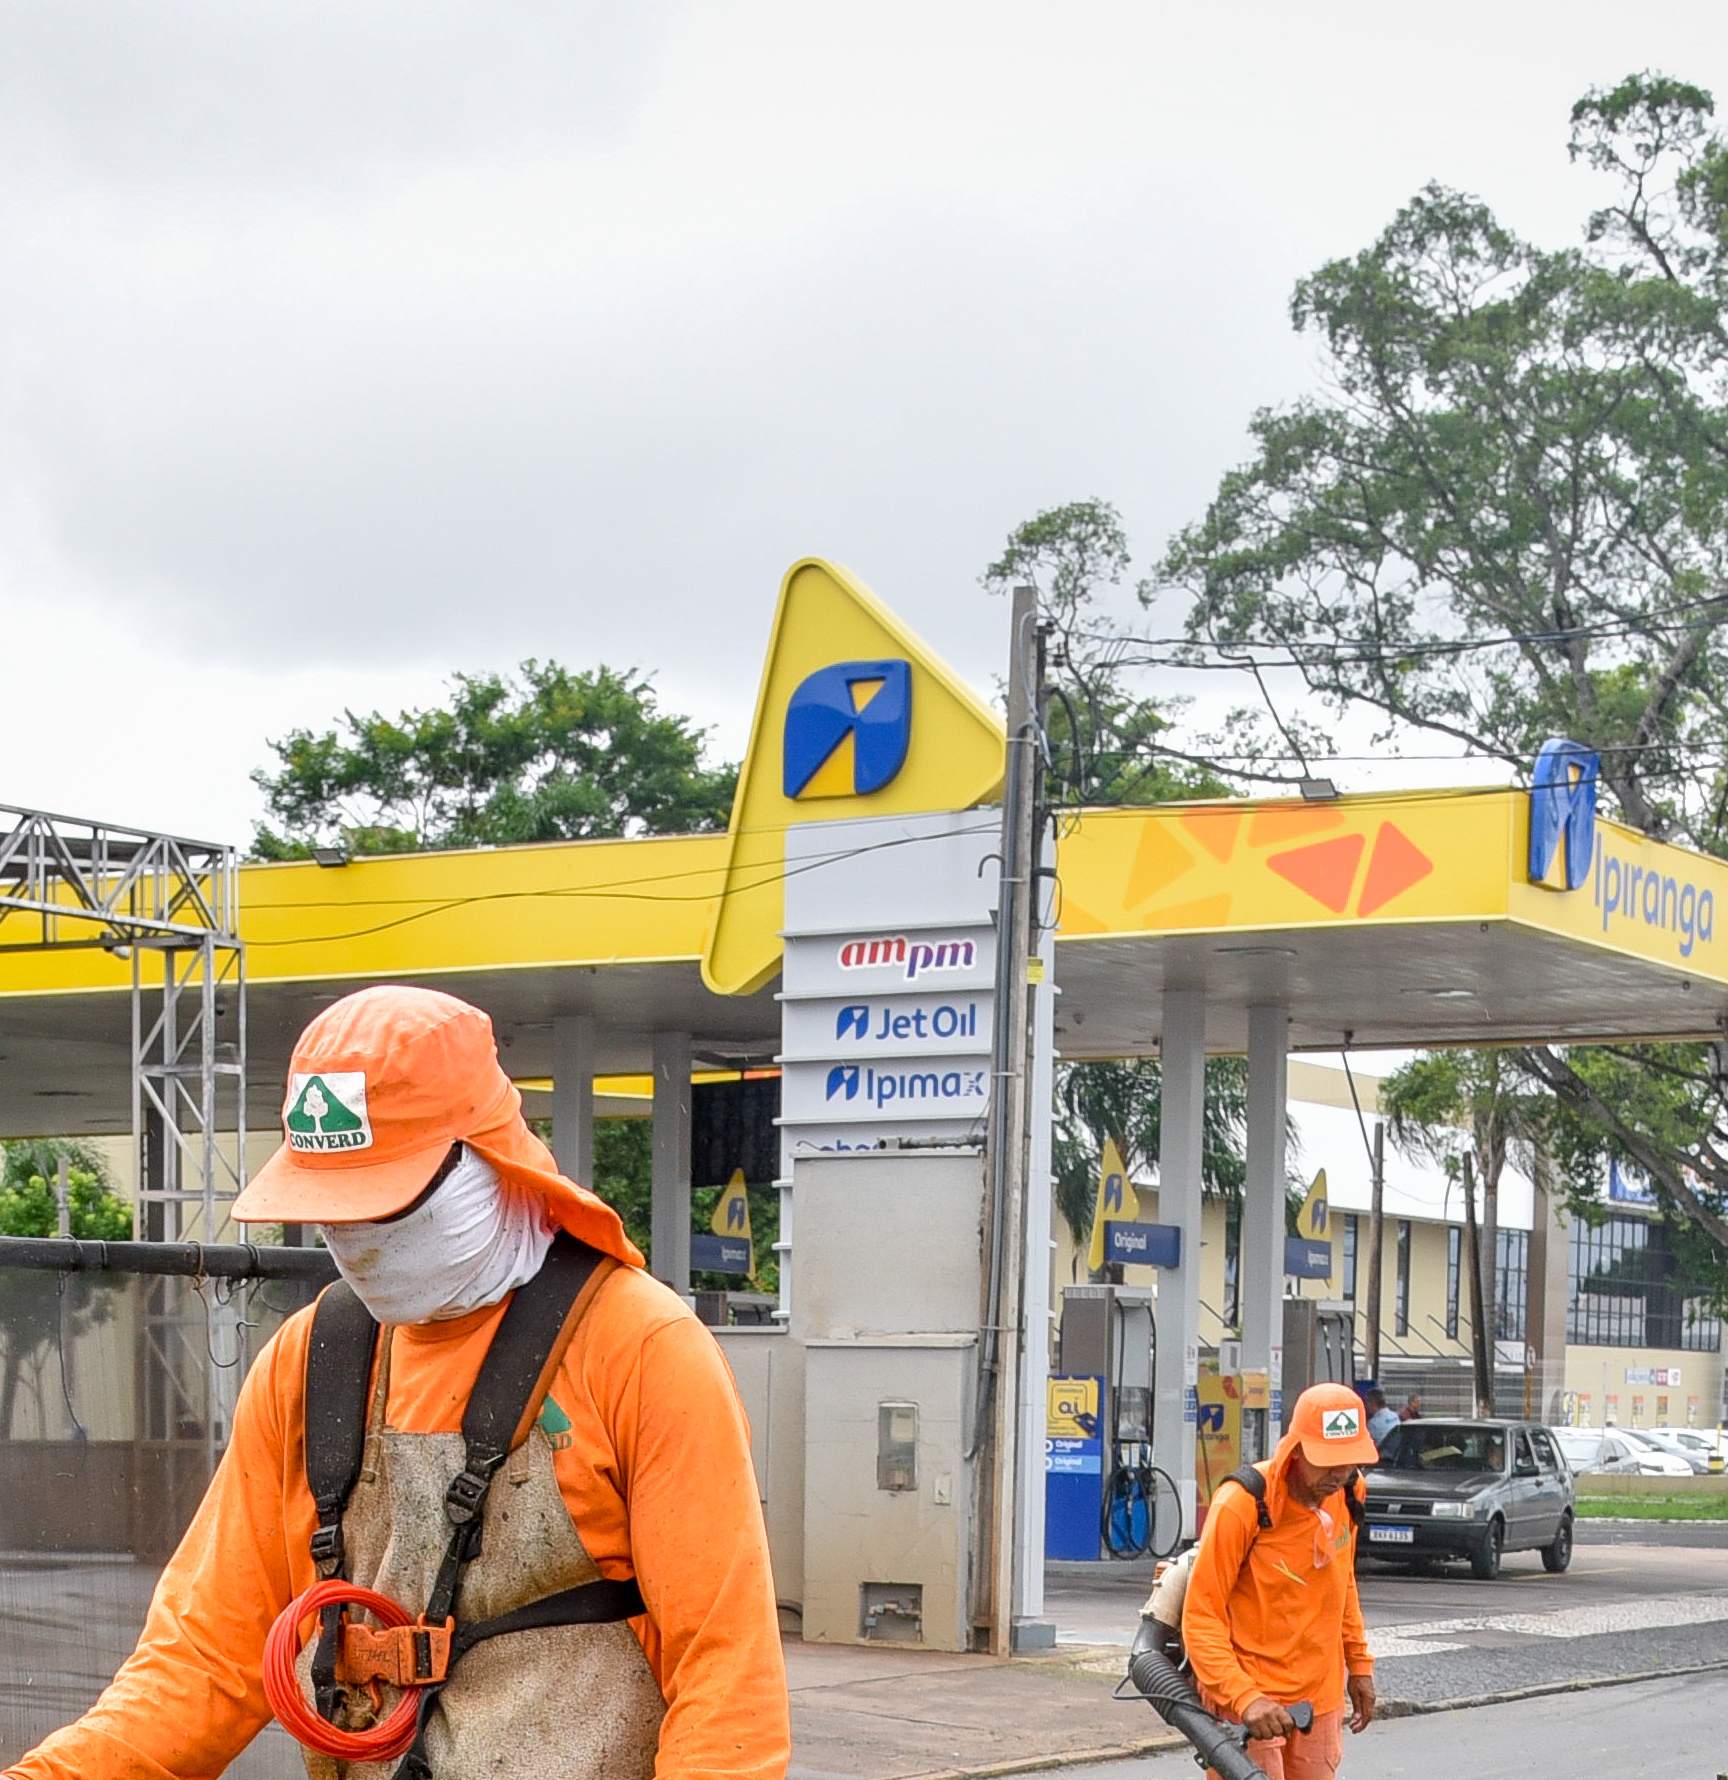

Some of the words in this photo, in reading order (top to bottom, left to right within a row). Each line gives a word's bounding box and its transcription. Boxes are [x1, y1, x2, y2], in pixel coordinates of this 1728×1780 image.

[1594, 831, 1713, 958] Ipiranga
[839, 936, 975, 978] ampm
[867, 1066, 985, 1109] Ipimax
[289, 1131, 367, 1149] CONVERD
[1114, 1231, 1147, 1253] Original
